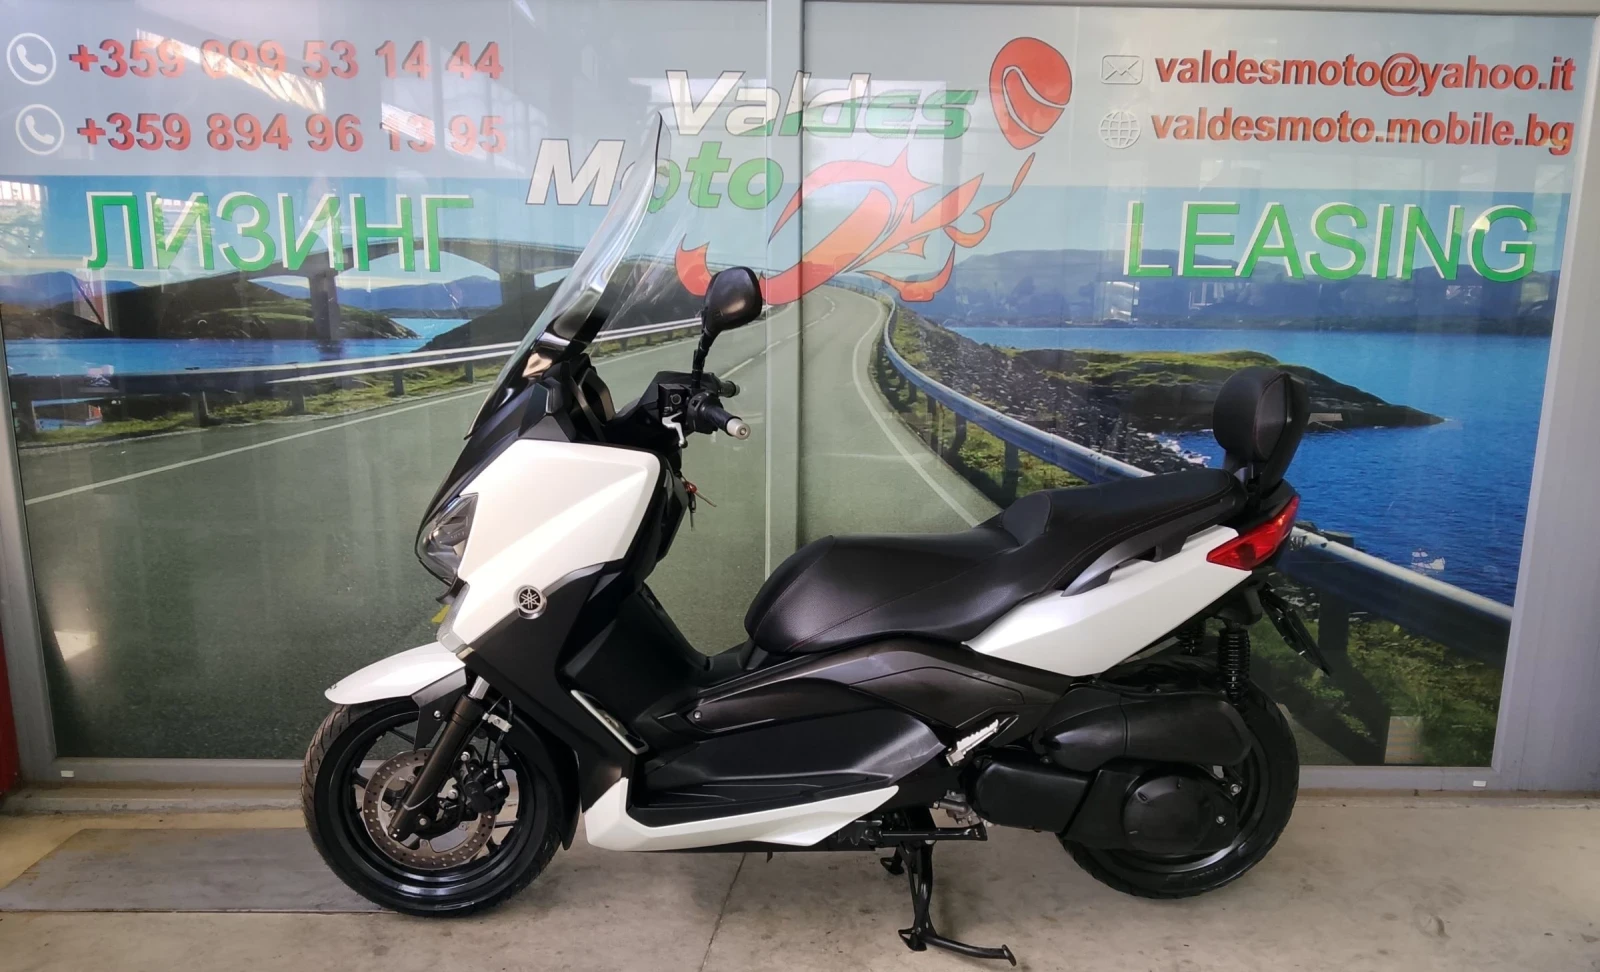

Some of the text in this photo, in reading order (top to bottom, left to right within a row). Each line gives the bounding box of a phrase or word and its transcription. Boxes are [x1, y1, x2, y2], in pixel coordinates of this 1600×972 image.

[69, 39, 185, 79] +359
[302, 39, 359, 79] 53
[375, 40, 431, 79] 14
[445, 41, 504, 79] 44
[1155, 50, 1576, 96] valdesmoto@yahoo.it
[666, 70, 978, 139] Valdes
[77, 113, 191, 151] +359
[207, 113, 292, 151] 894
[306, 113, 363, 152] 96
[448, 114, 507, 153] 95
[1151, 107, 1575, 155] valdesmoto.mobile.bg
[83, 191, 474, 272] ЛИЗИНГ
[1122, 200, 1538, 283] LEASING
